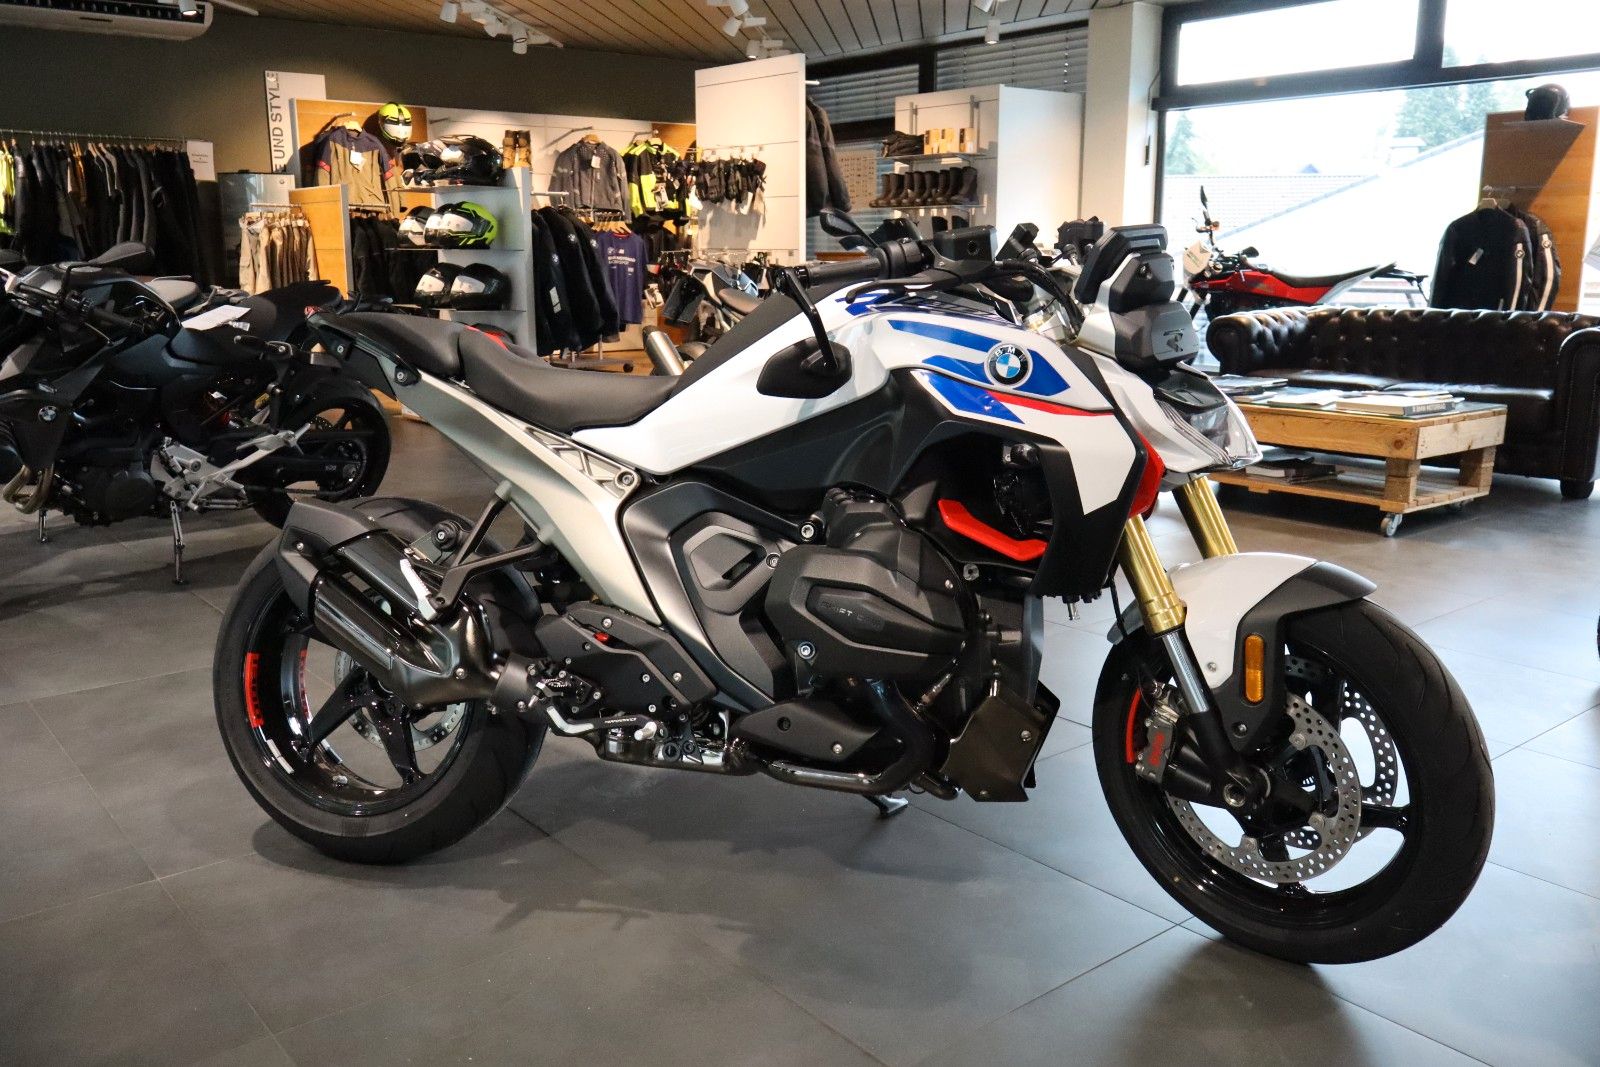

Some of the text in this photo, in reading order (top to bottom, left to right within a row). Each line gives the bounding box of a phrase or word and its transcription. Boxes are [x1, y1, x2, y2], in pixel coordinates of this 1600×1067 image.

[266, 72, 283, 123] STYLE
[272, 127, 286, 159] UND
[994, 345, 1027, 363] BMW
